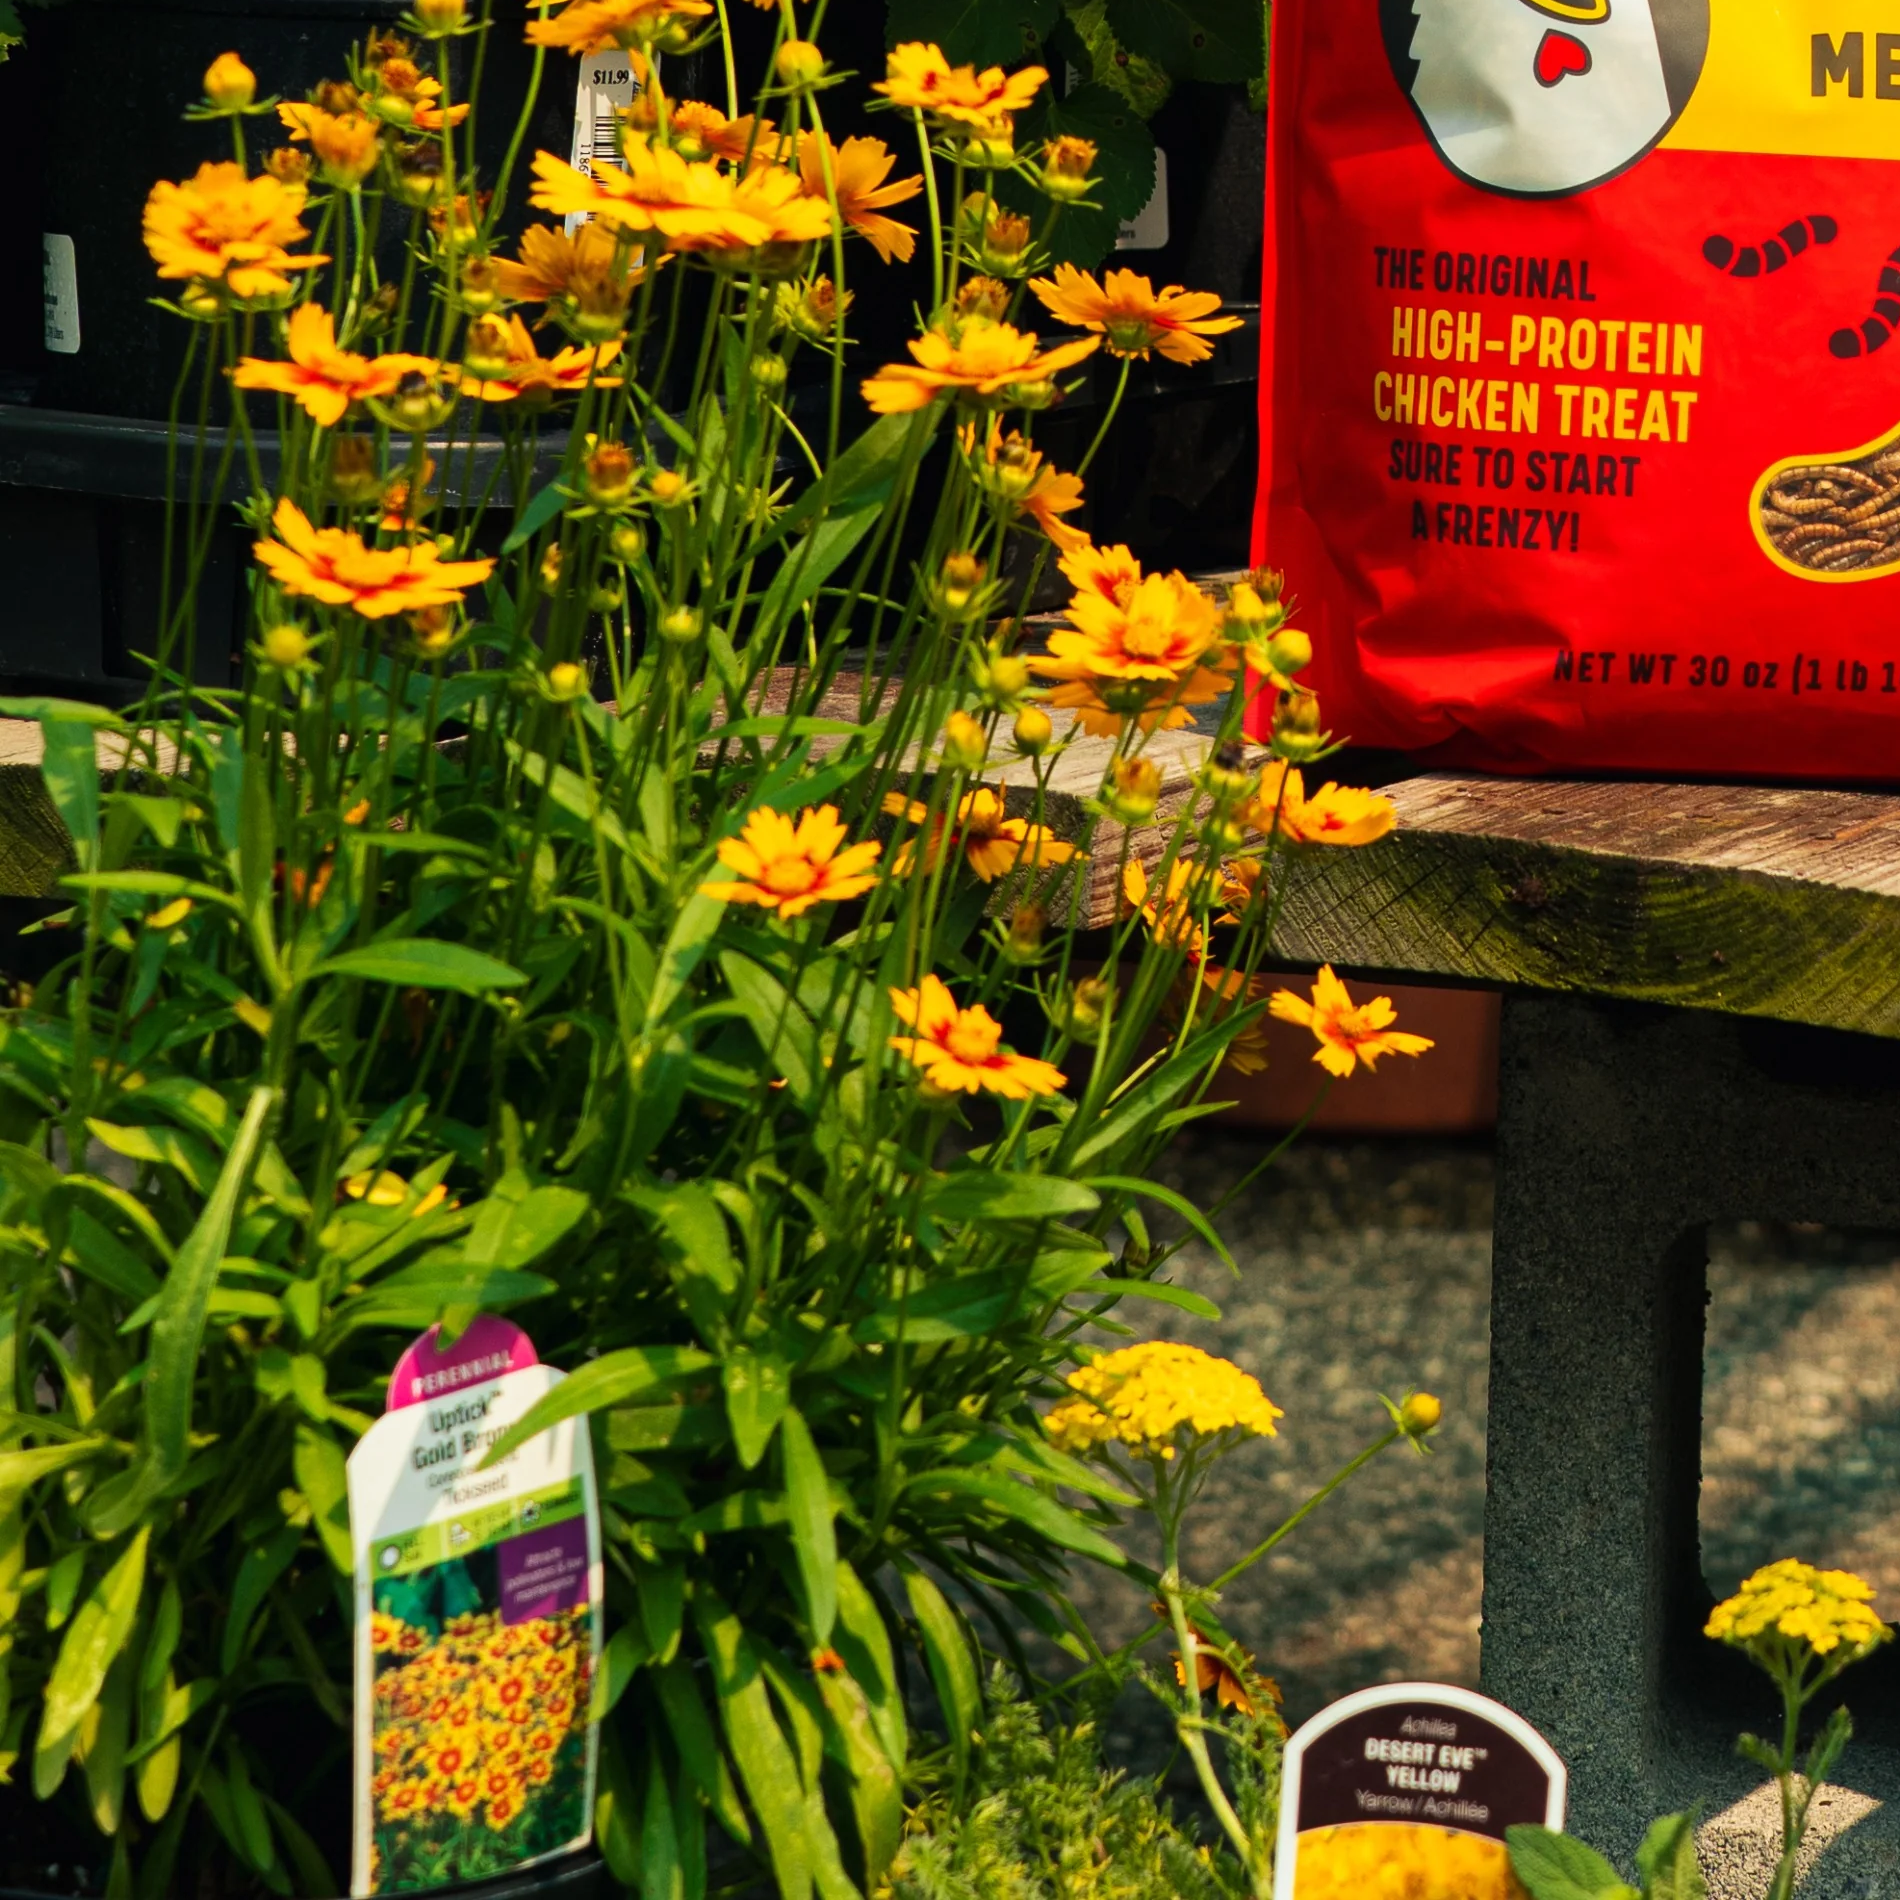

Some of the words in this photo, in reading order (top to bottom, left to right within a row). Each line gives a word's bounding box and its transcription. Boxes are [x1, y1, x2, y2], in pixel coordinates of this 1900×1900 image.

[593, 69, 629, 85] $11.99
[1374, 246, 1425, 291] THE
[1434, 251, 1597, 302] ORIGINAL
[1392, 306, 1703, 377] HIGH-PROTEIN
[1374, 371, 1540, 434] CHICKEN
[1554, 384, 1698, 443] TREAT
[1388, 439, 1462, 486] SURE
[1473, 447, 1514, 490] TO
[1525, 450, 1641, 497] START
[1412, 499, 1428, 541] A
[1437, 502, 1580, 553] FRENZY!
[1553, 649, 1616, 683] NET
[1629, 652, 1678, 685] WT
[1688, 654, 1730, 688] 30
[1743, 661, 1779, 690] oz
[1791, 652, 1822, 696] (1
[1836, 659, 1868, 692] lb
[411, 1349, 514, 1398] PERENNIAL
[1364, 1737, 1436, 1765] DESERT
[1400, 1714, 1457, 1740] Achillea
[1355, 1788, 1414, 1815] Yarrow
[1386, 1764, 1461, 1794] YELLOW
